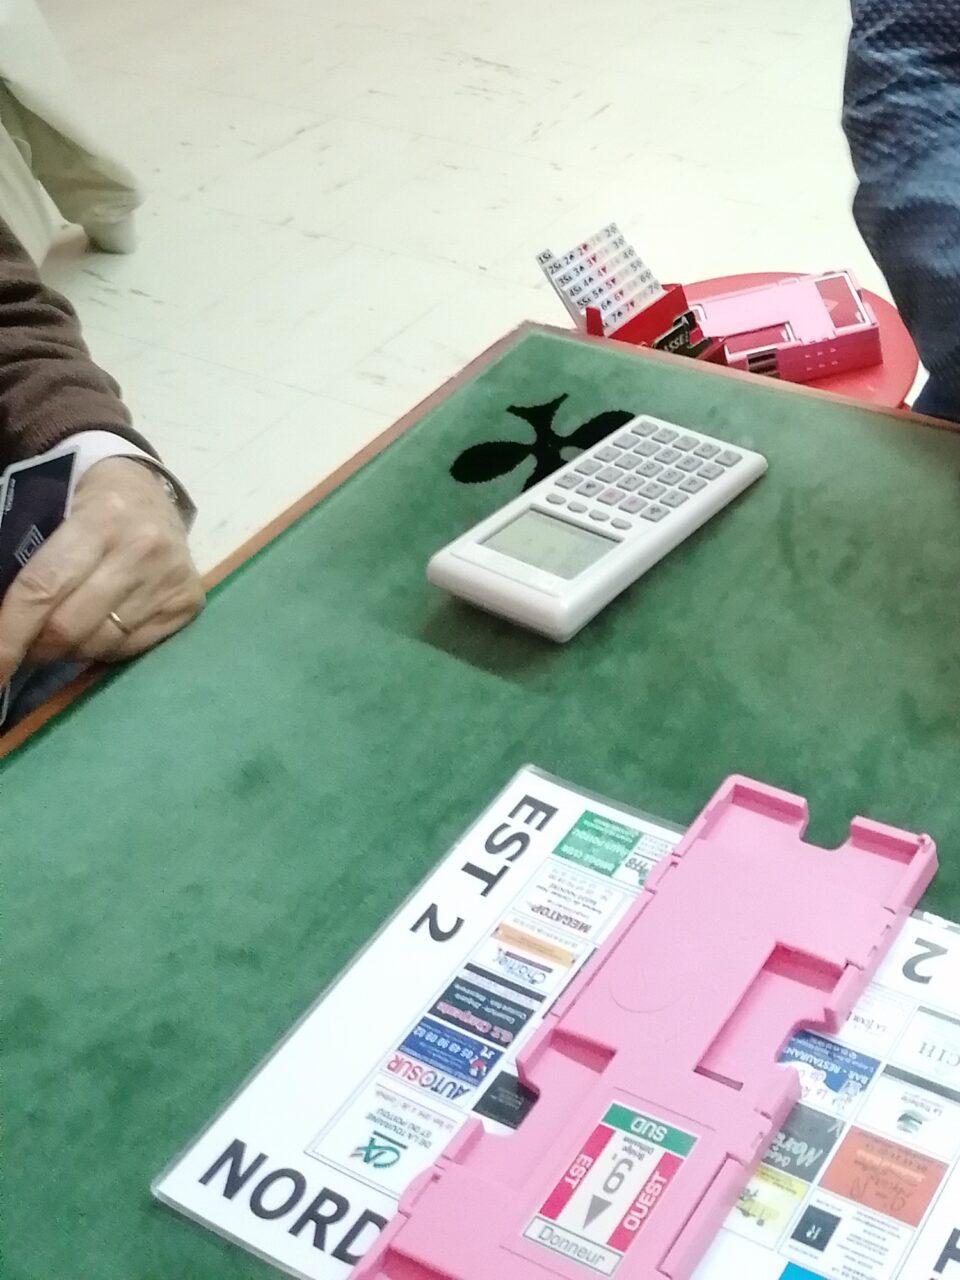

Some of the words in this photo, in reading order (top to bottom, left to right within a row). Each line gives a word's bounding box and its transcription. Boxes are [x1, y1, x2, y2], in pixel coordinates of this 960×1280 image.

[461, 794, 559, 897] EST
[410, 903, 464, 943] 2
[902, 937, 948, 984] 2
[385, 1054, 469, 1100] AUTOSUR
[630, 1117, 668, 1143] SUD
[564, 1154, 595, 1188] EST
[197, 1138, 389, 1266] NORD
[623, 1171, 668, 1232] OUEST
[538, 1225, 606, 1266] Donneur
